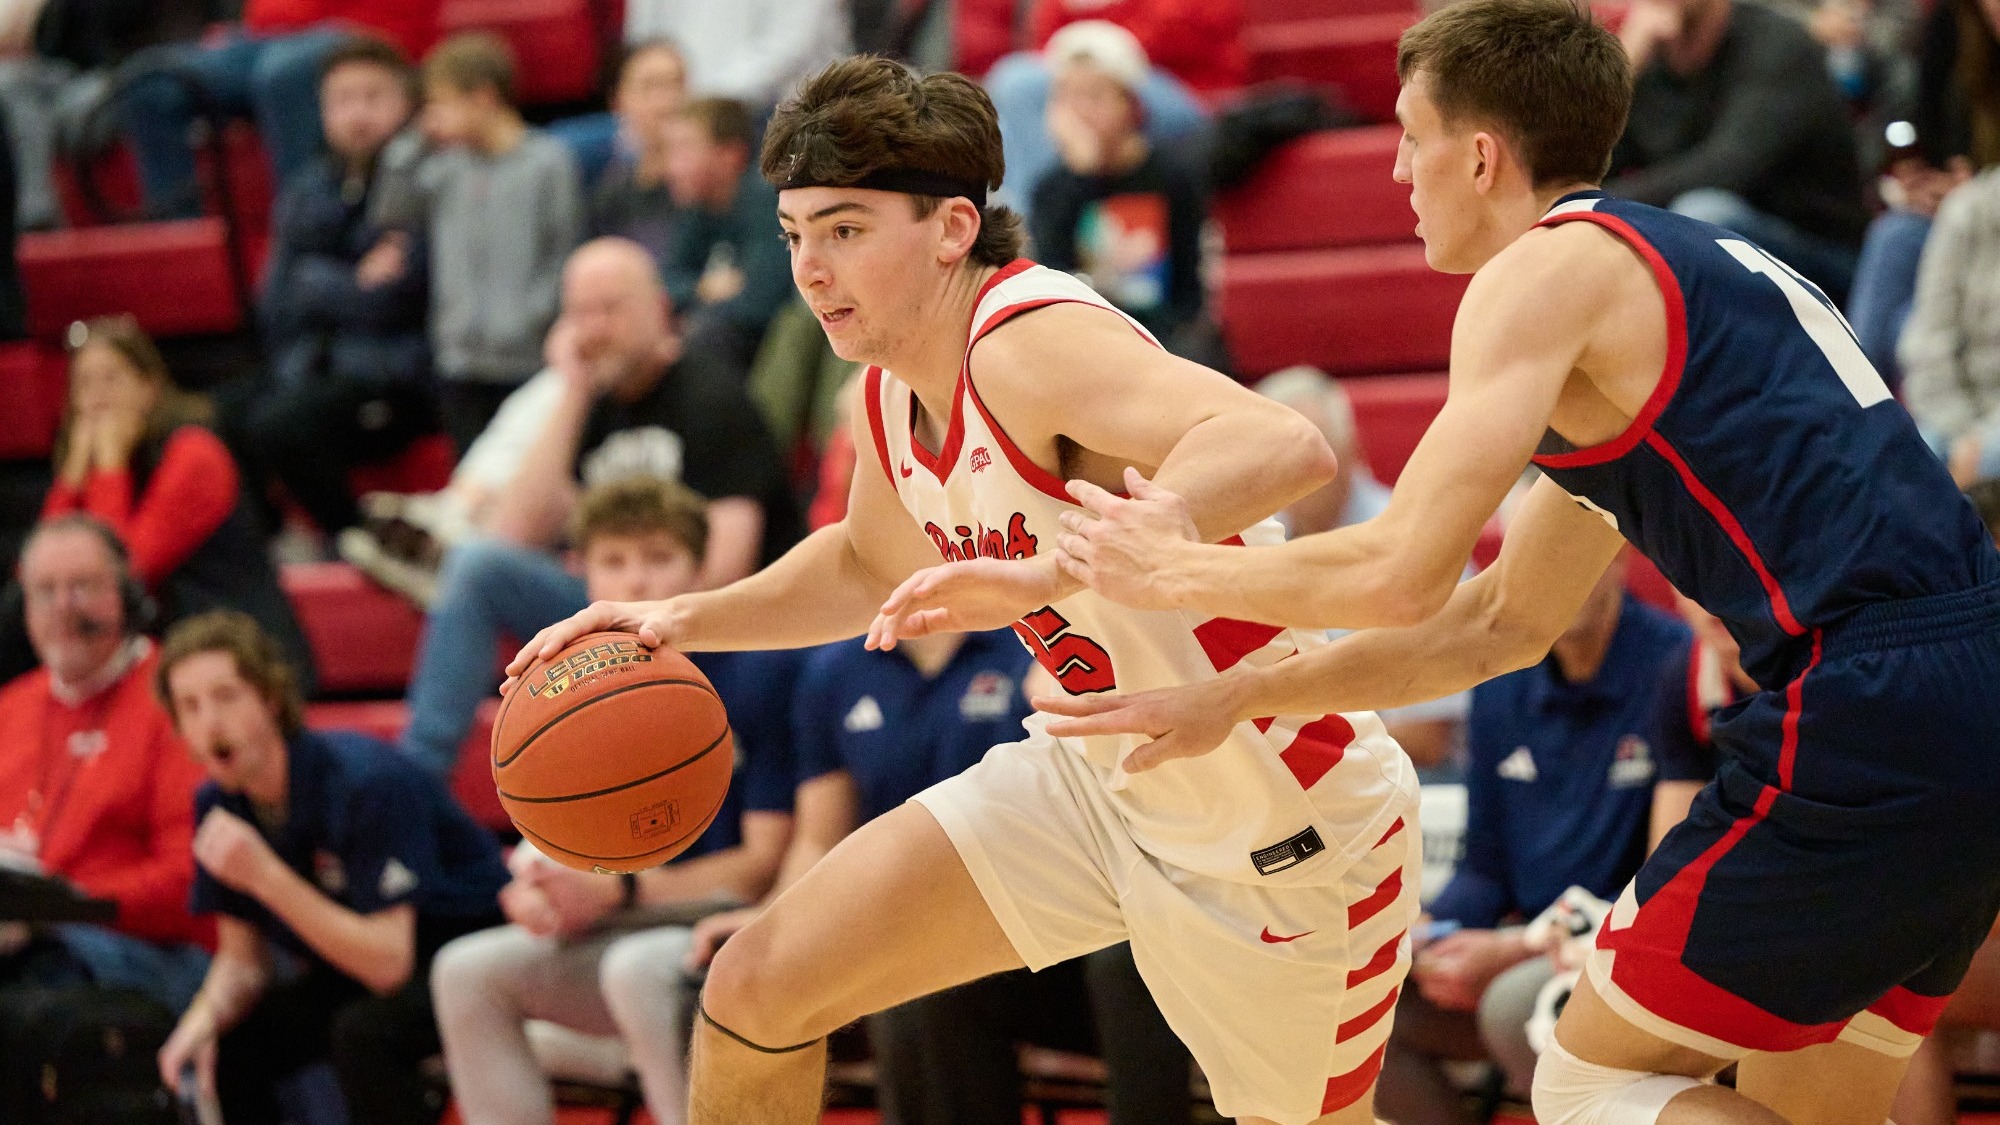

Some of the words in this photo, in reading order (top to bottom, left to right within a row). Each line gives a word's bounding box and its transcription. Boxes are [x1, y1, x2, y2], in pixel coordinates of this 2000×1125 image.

[1714, 239, 1895, 409] 1
[1009, 605, 1117, 696] 5
[570, 675, 599, 692] OFFICIAL
[601, 669, 618, 679] GAME
[621, 665, 636, 673] BALL
[572, 654, 653, 681] 1000
[1301, 843, 1312, 852] L
